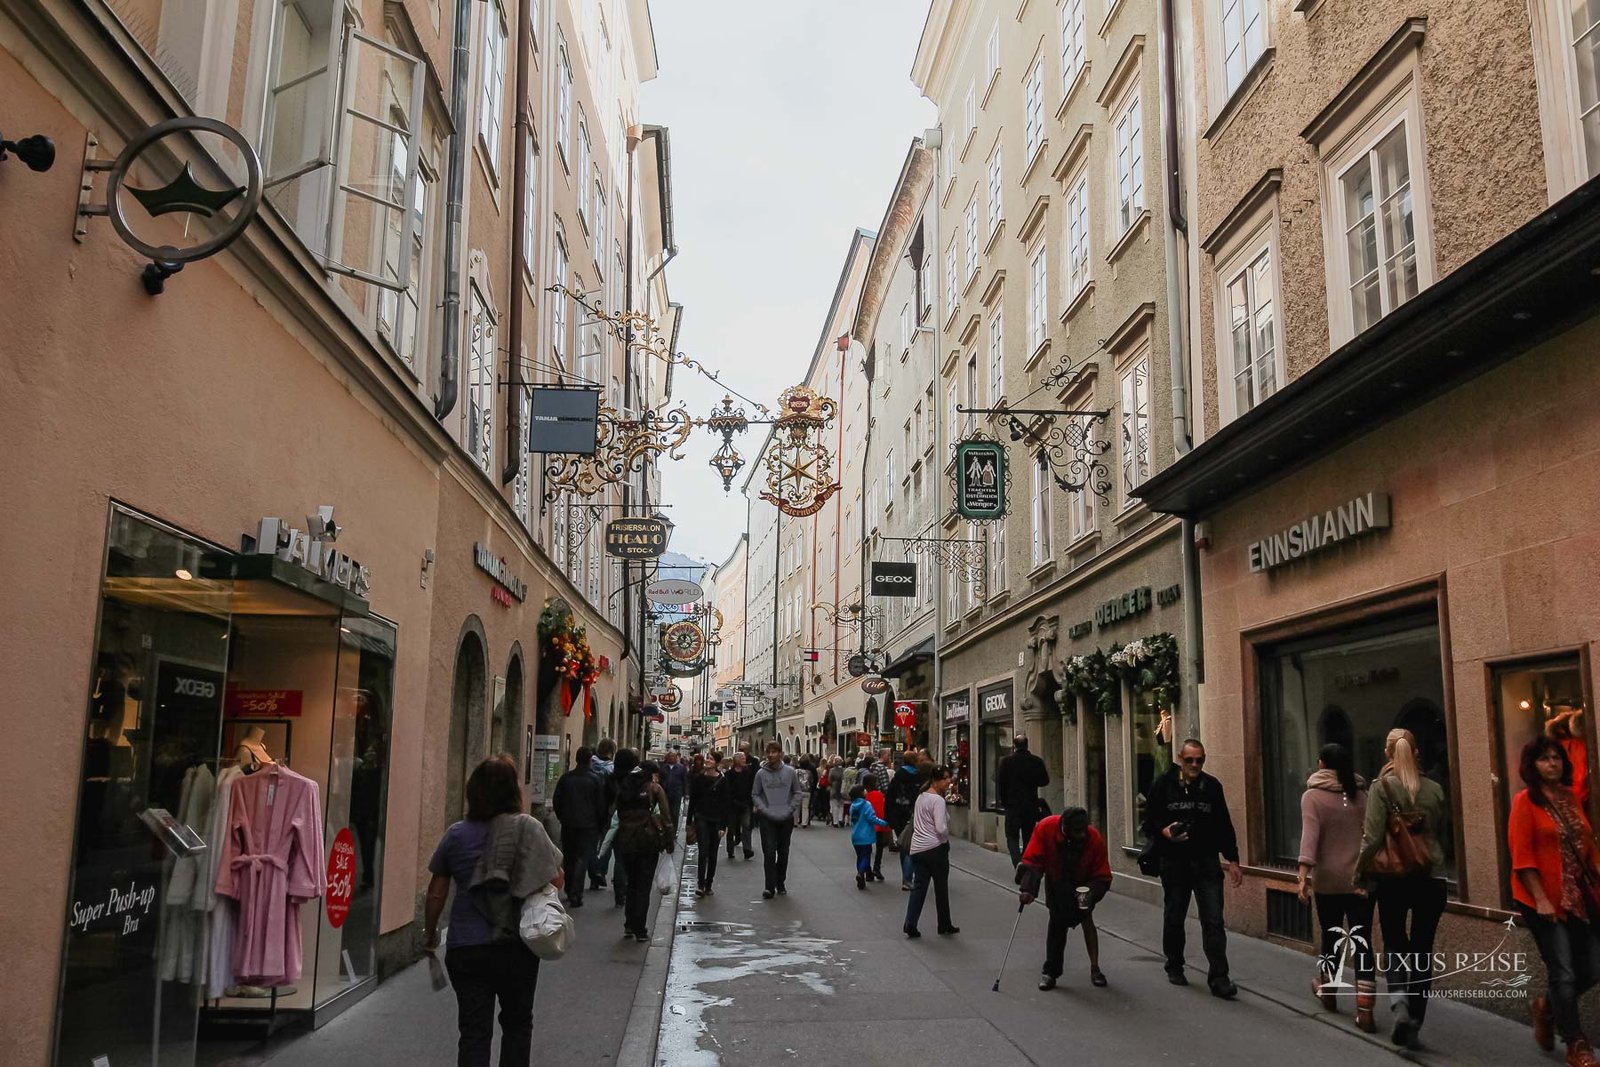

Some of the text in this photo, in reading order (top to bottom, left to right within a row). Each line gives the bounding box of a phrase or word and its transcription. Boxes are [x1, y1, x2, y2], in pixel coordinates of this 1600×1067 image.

[611, 524, 661, 532] FRISIERSALON
[1248, 492, 1374, 575] ENNSMANN
[256, 516, 371, 597] PALMERS
[875, 575, 913, 583] GEOX
[1094, 586, 1152, 627] WENGER
[985, 692, 1007, 712] GEOX
[70, 881, 155, 932] Super Push-up
[122, 915, 140, 936] Bra
